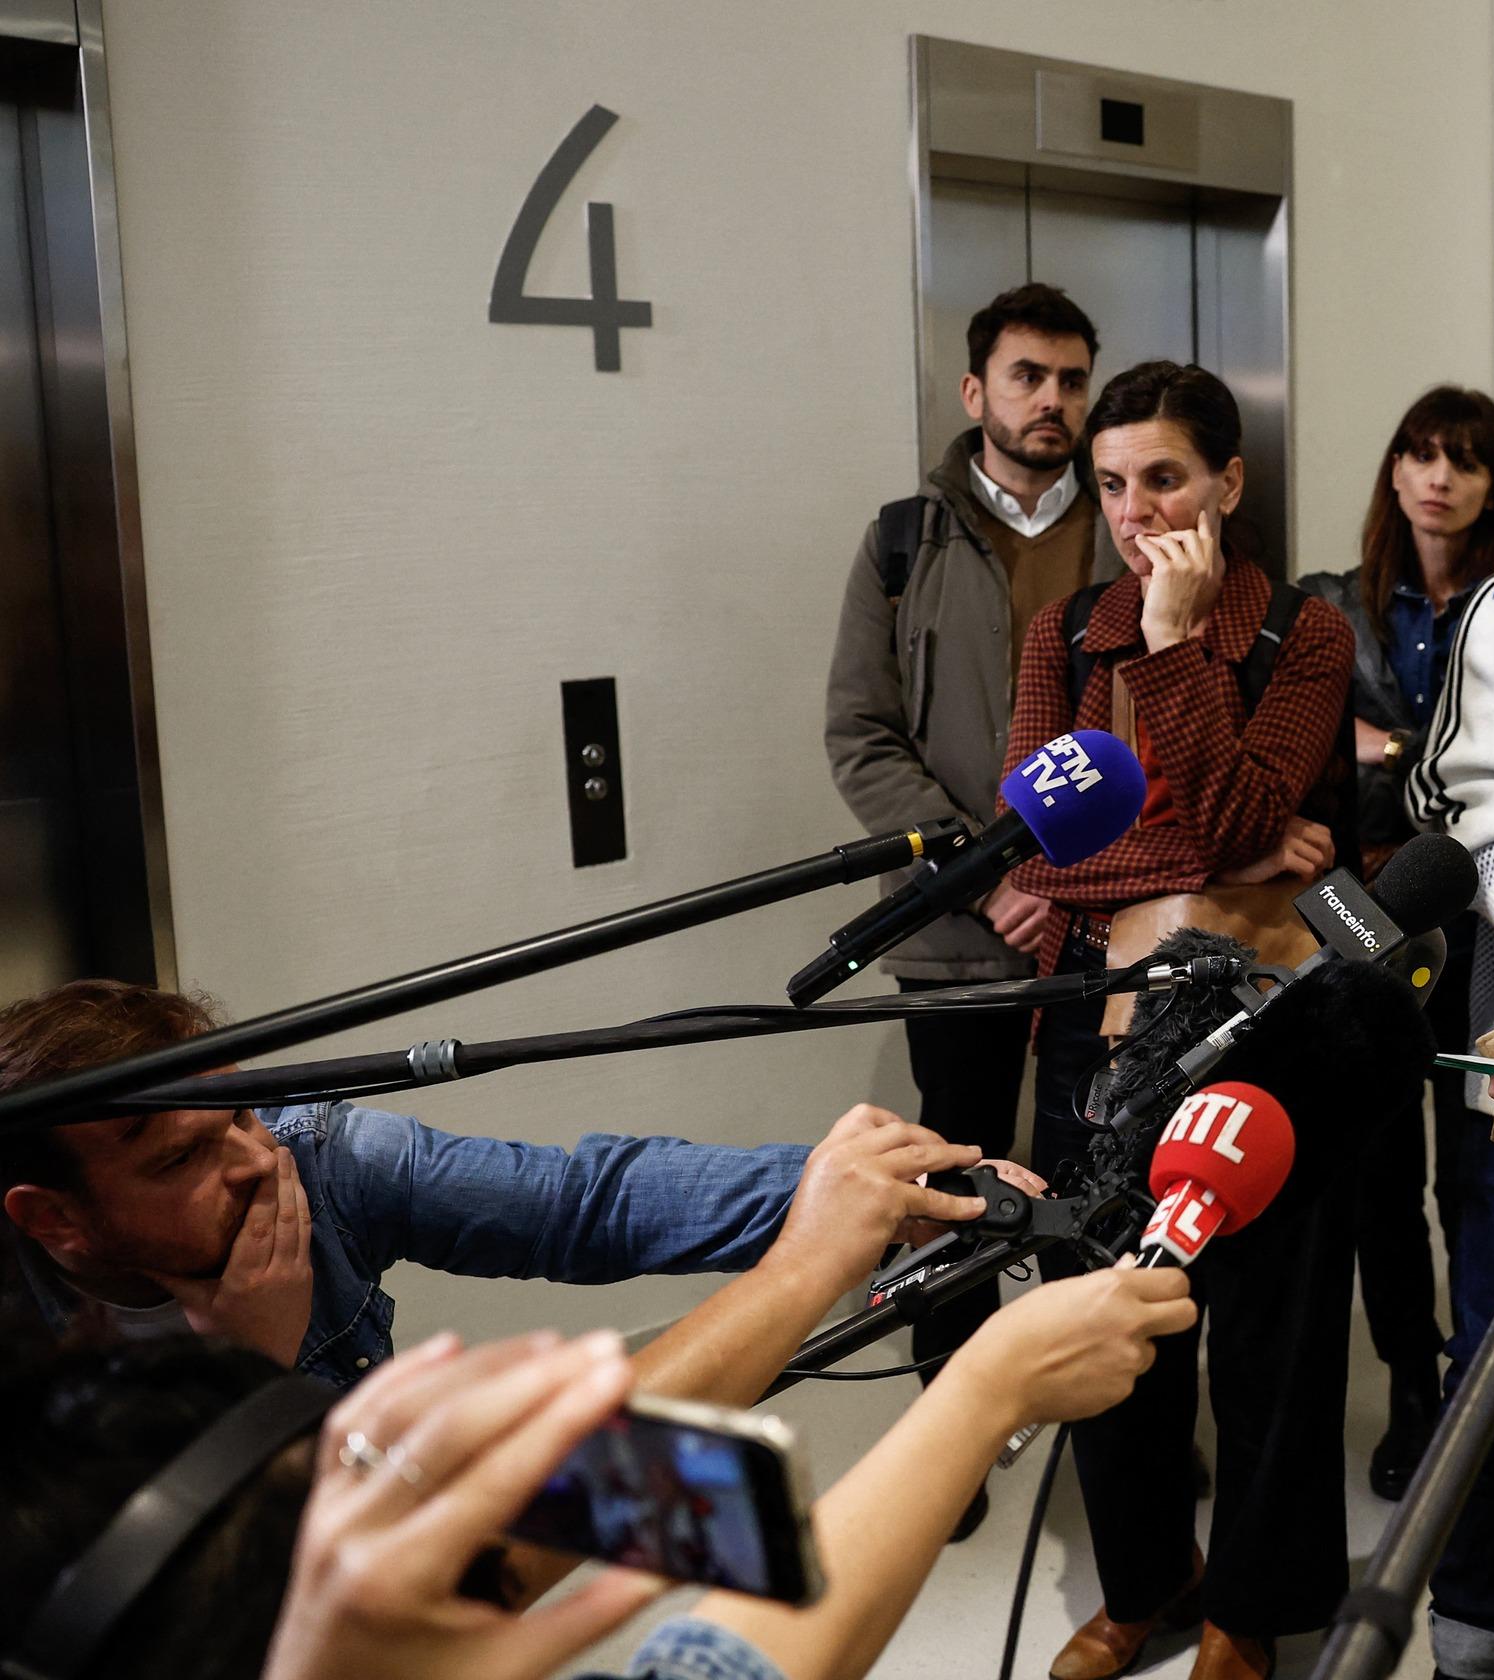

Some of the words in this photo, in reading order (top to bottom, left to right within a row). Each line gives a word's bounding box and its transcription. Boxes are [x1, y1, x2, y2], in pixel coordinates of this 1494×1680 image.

[488, 103, 653, 373] 4
[1043, 733, 1103, 793] BFM
[1159, 1092, 1254, 1164] RTL
